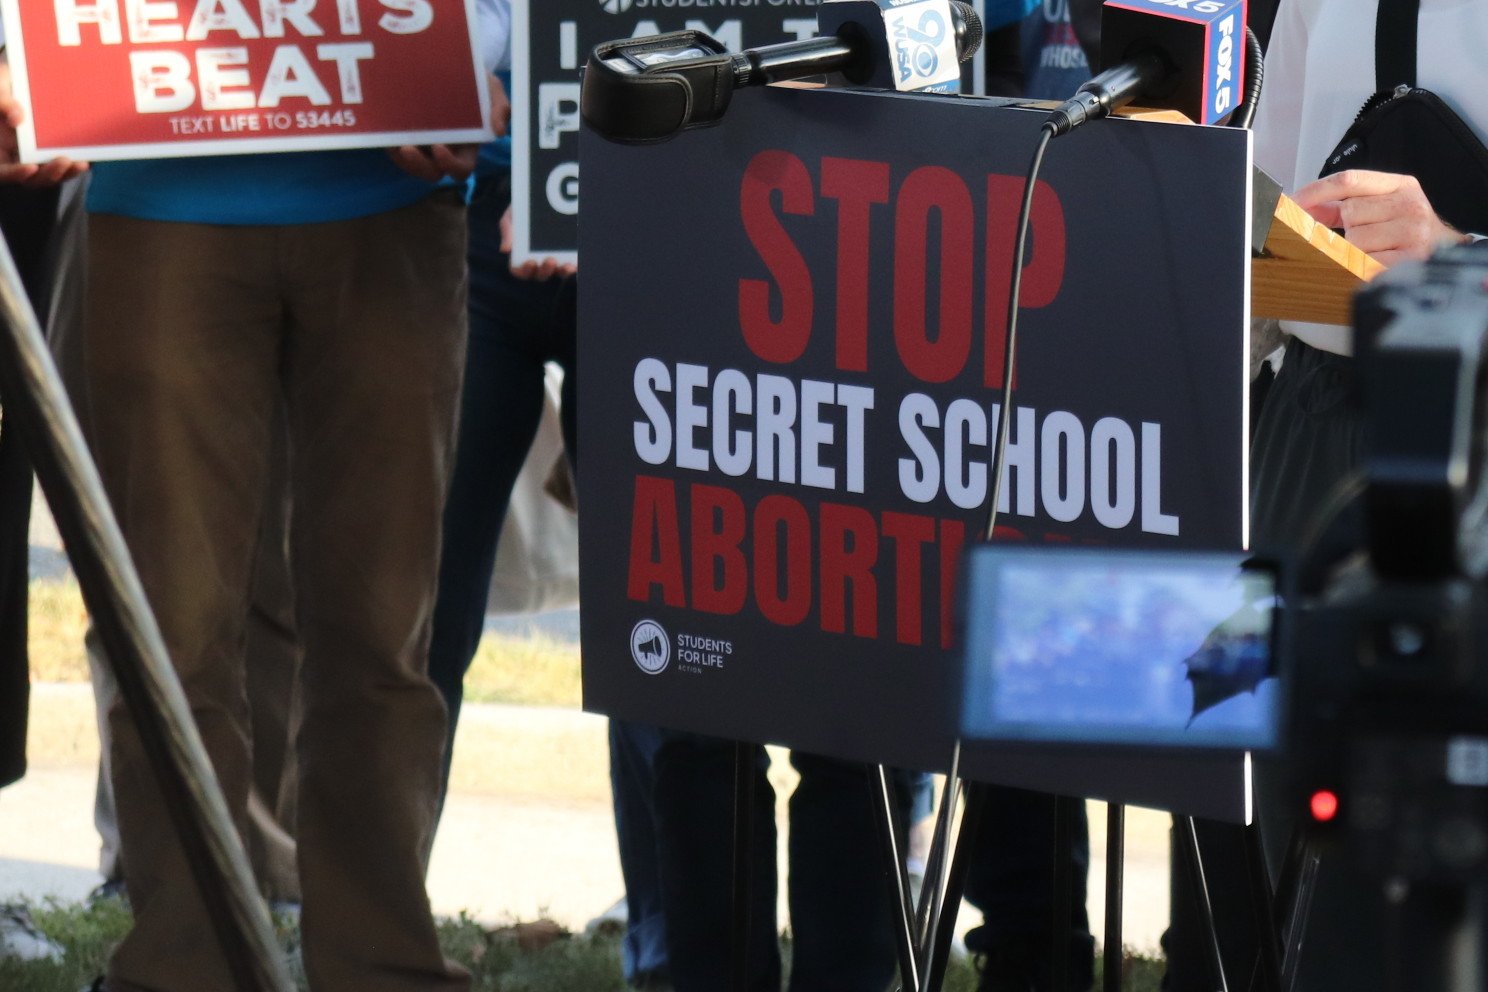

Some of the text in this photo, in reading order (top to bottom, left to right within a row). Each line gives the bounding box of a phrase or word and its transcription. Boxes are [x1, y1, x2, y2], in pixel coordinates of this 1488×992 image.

[1193, 0, 1227, 13] 5
[559, 20, 577, 70] I
[891, 15, 913, 84] WUSA
[1214, 13, 1235, 114] FOX 5
[128, 41, 375, 115] BEAT
[169, 109, 356, 135] TEXT LIFE TO 53445
[737, 148, 1067, 391] STOP
[632, 356, 1181, 537] SECRET SCHOOL
[676, 633, 733, 655] STUDENTS
[677, 648, 724, 669] FOR LIFE
